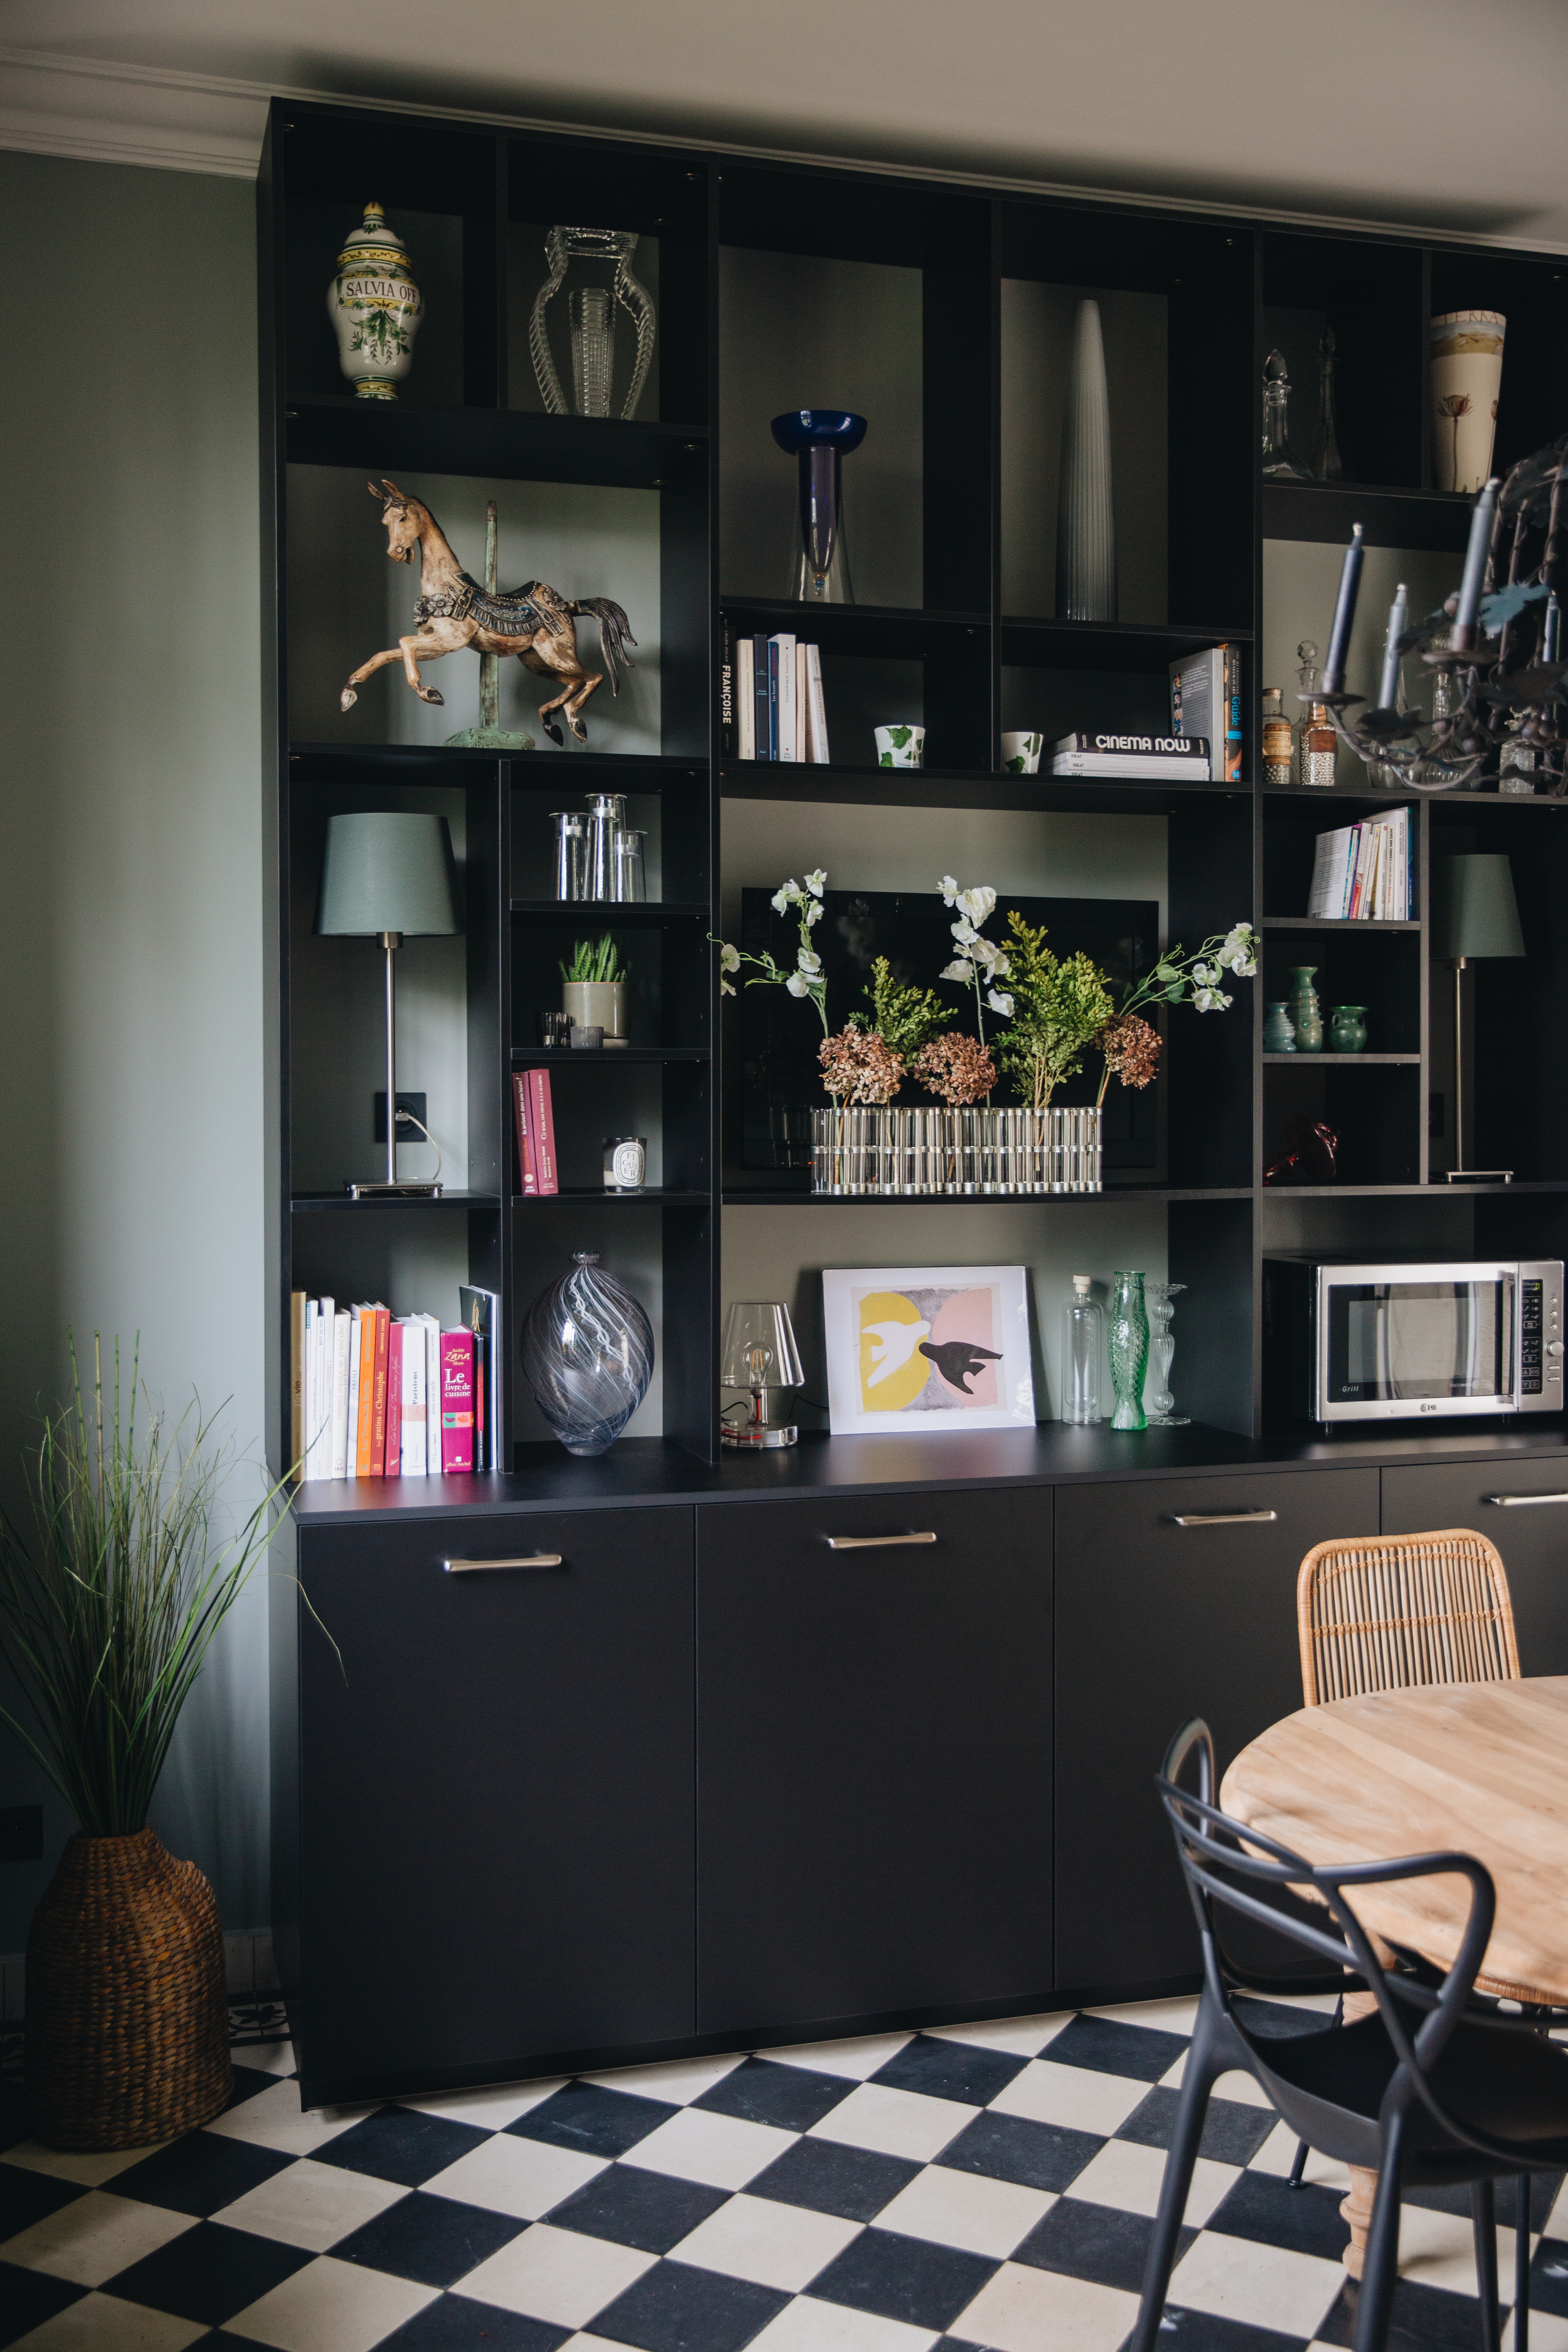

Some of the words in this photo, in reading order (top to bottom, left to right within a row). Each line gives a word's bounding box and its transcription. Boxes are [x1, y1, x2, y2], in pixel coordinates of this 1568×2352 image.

[346, 281, 395, 297] SALVIA
[721, 665, 731, 724] FRANÇOISE
[1232, 696, 1241, 726] Guide
[1096, 735, 1151, 750] CINEMA
[1155, 738, 1190, 752] NOW
[391, 1356, 401, 1374] Sophie
[445, 1352, 470, 1361] Zana
[445, 1368, 465, 1383] Le
[375, 1371, 385, 1409] Christophe
[390, 1432, 396, 1445] La
